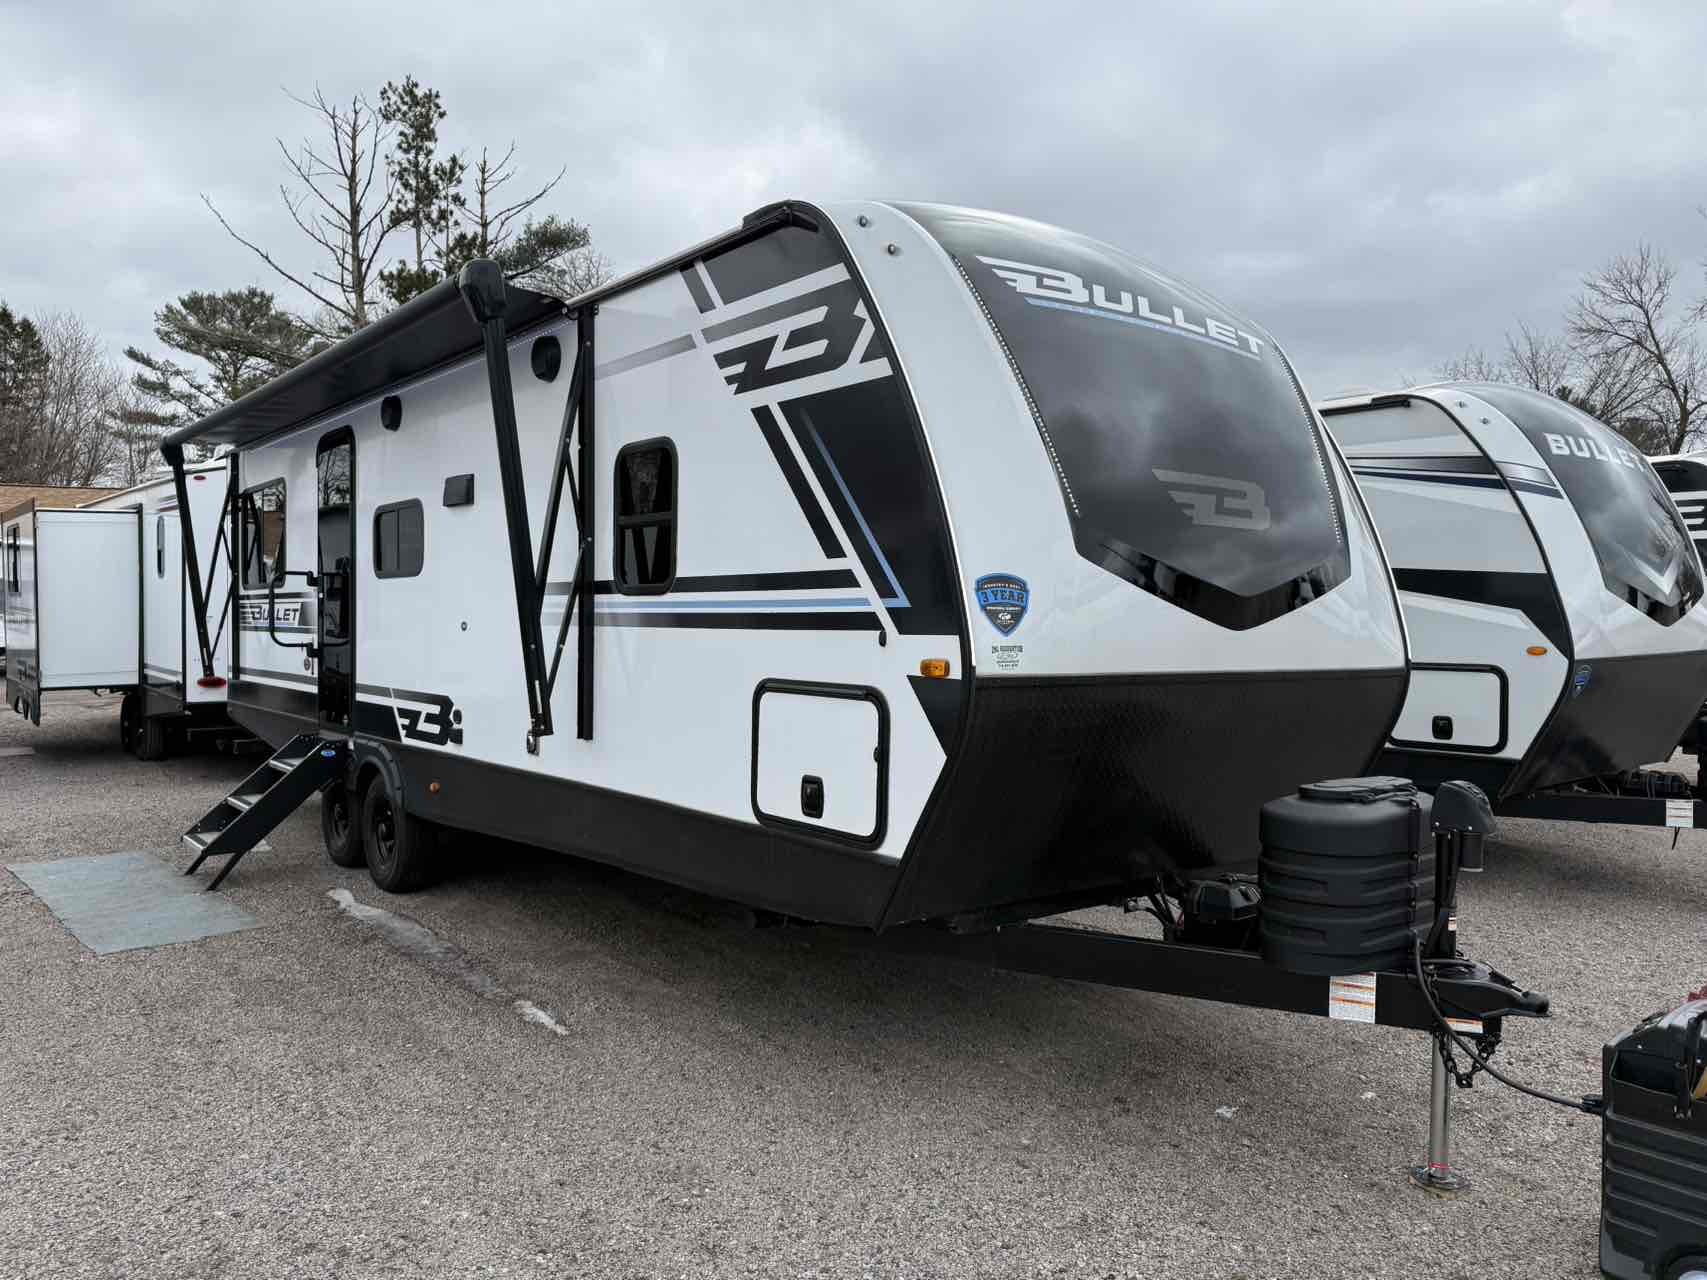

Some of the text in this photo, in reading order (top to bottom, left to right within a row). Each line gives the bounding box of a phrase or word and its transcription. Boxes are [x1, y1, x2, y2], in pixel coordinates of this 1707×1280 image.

[975, 255, 1264, 354] BULLET
[1543, 432, 1645, 472] BULLET
[991, 590, 1025, 603] YEAR
[249, 604, 299, 622] BULET
